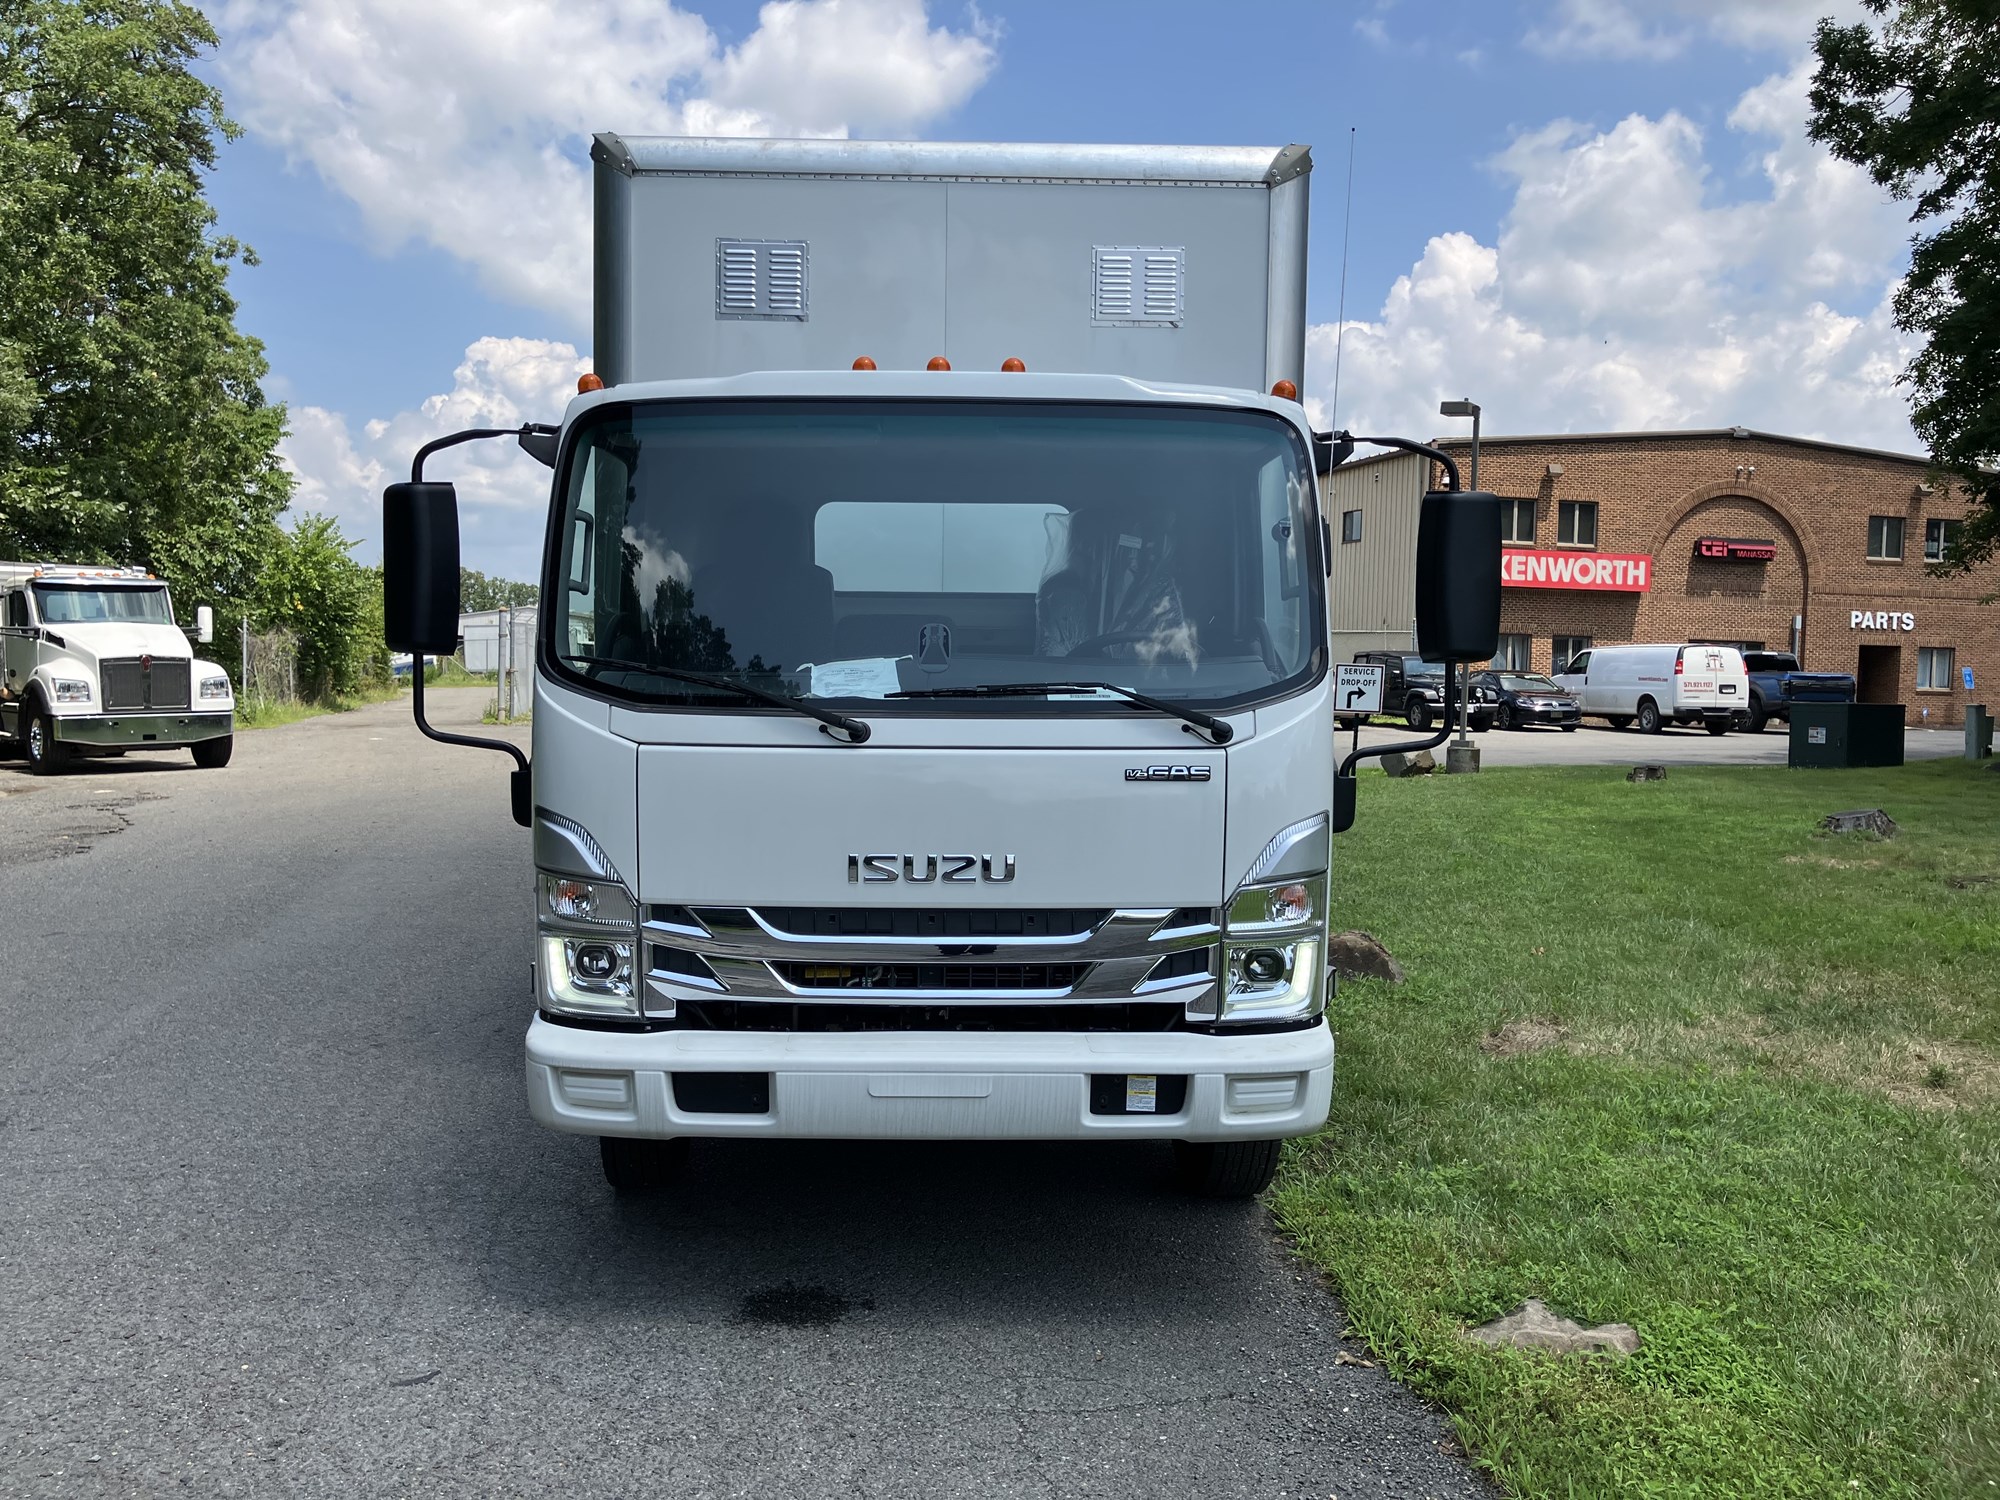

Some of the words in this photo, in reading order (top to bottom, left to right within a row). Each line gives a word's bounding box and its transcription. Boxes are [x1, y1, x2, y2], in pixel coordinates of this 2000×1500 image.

[1736, 550, 1776, 559] MANASSAS
[1850, 610, 1915, 631] PARTS
[1343, 667, 1376, 676] SERVICE
[1340, 678, 1377, 687] DROP-OFF
[1147, 765, 1211, 781] GAS
[848, 853, 1016, 884] ISUZU
